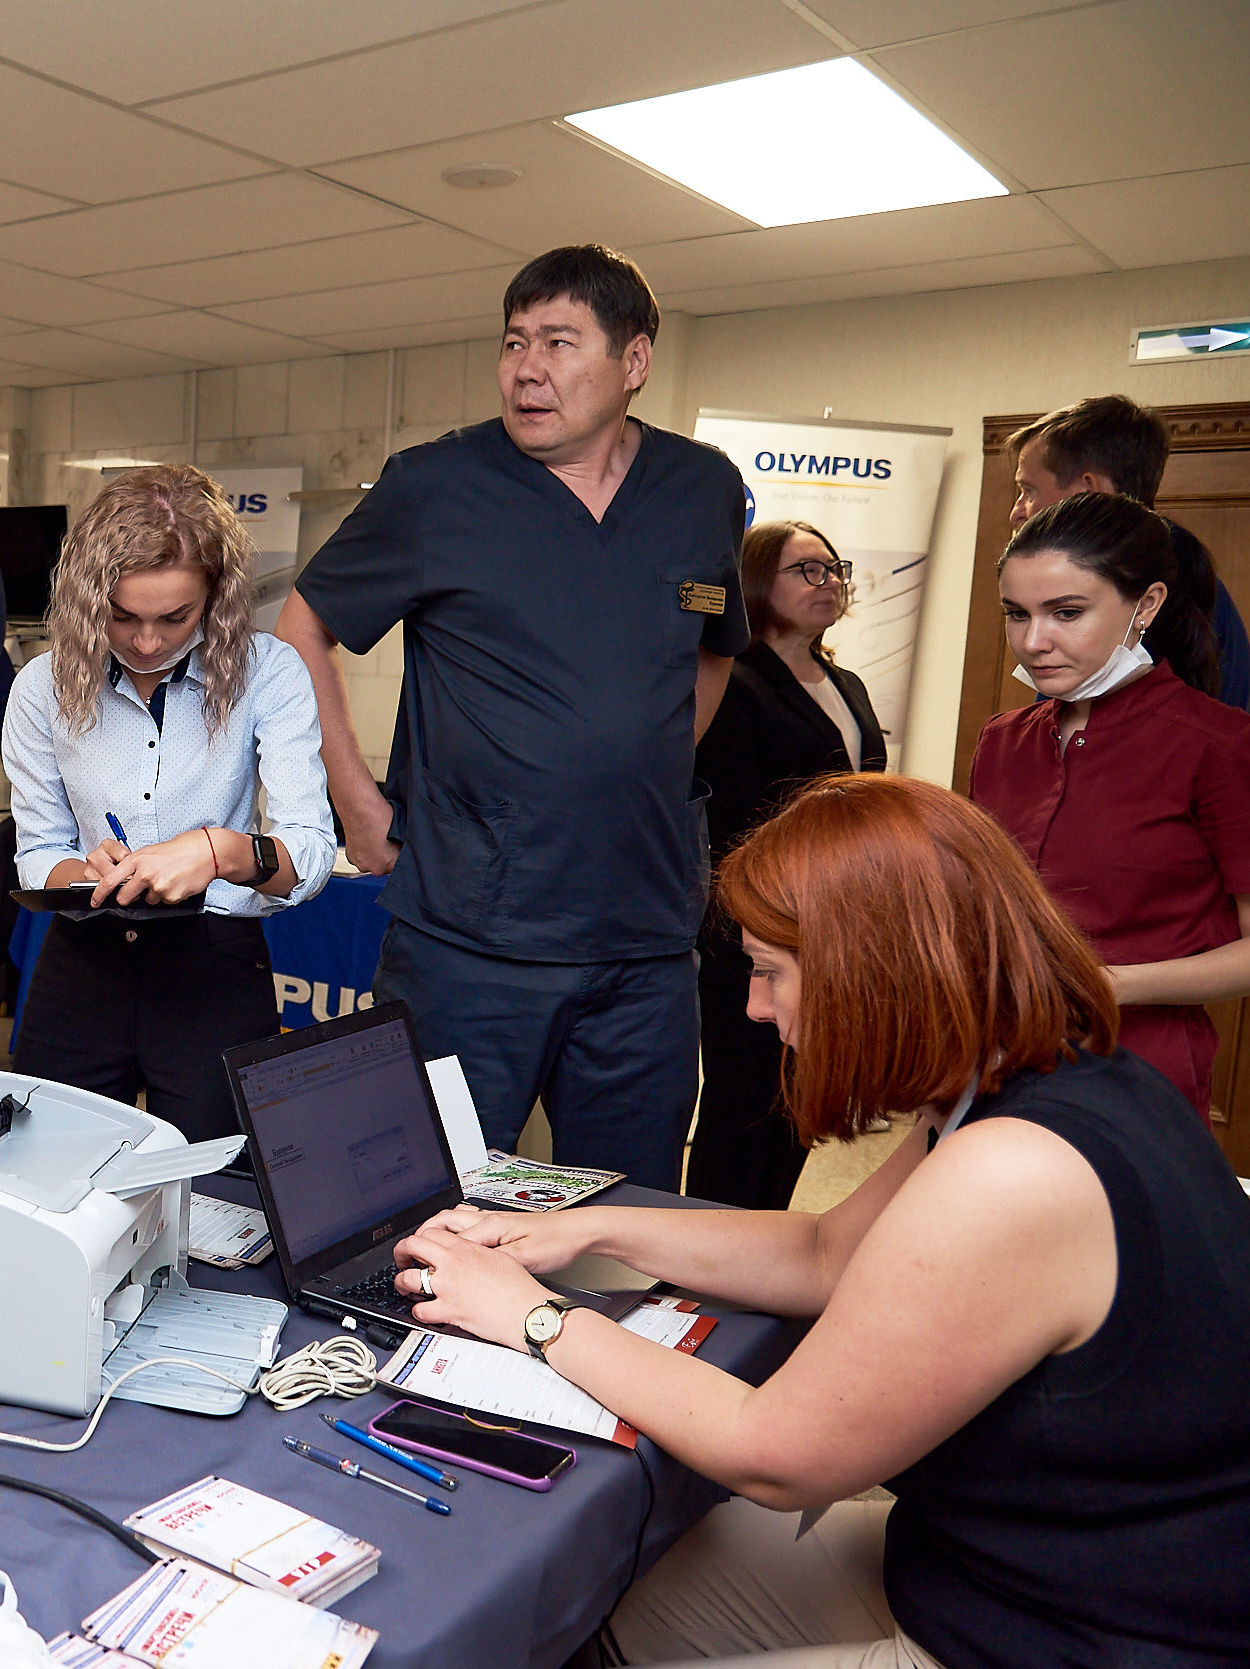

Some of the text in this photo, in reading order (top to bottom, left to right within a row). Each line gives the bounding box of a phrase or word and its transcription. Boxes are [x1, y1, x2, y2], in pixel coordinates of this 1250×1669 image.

[755, 451, 892, 479] OLYMPUS
[229, 493, 268, 514] US
[164, 1503, 213, 1530] ВСТРЕЧИ
[291, 1557, 321, 1580] VIP
